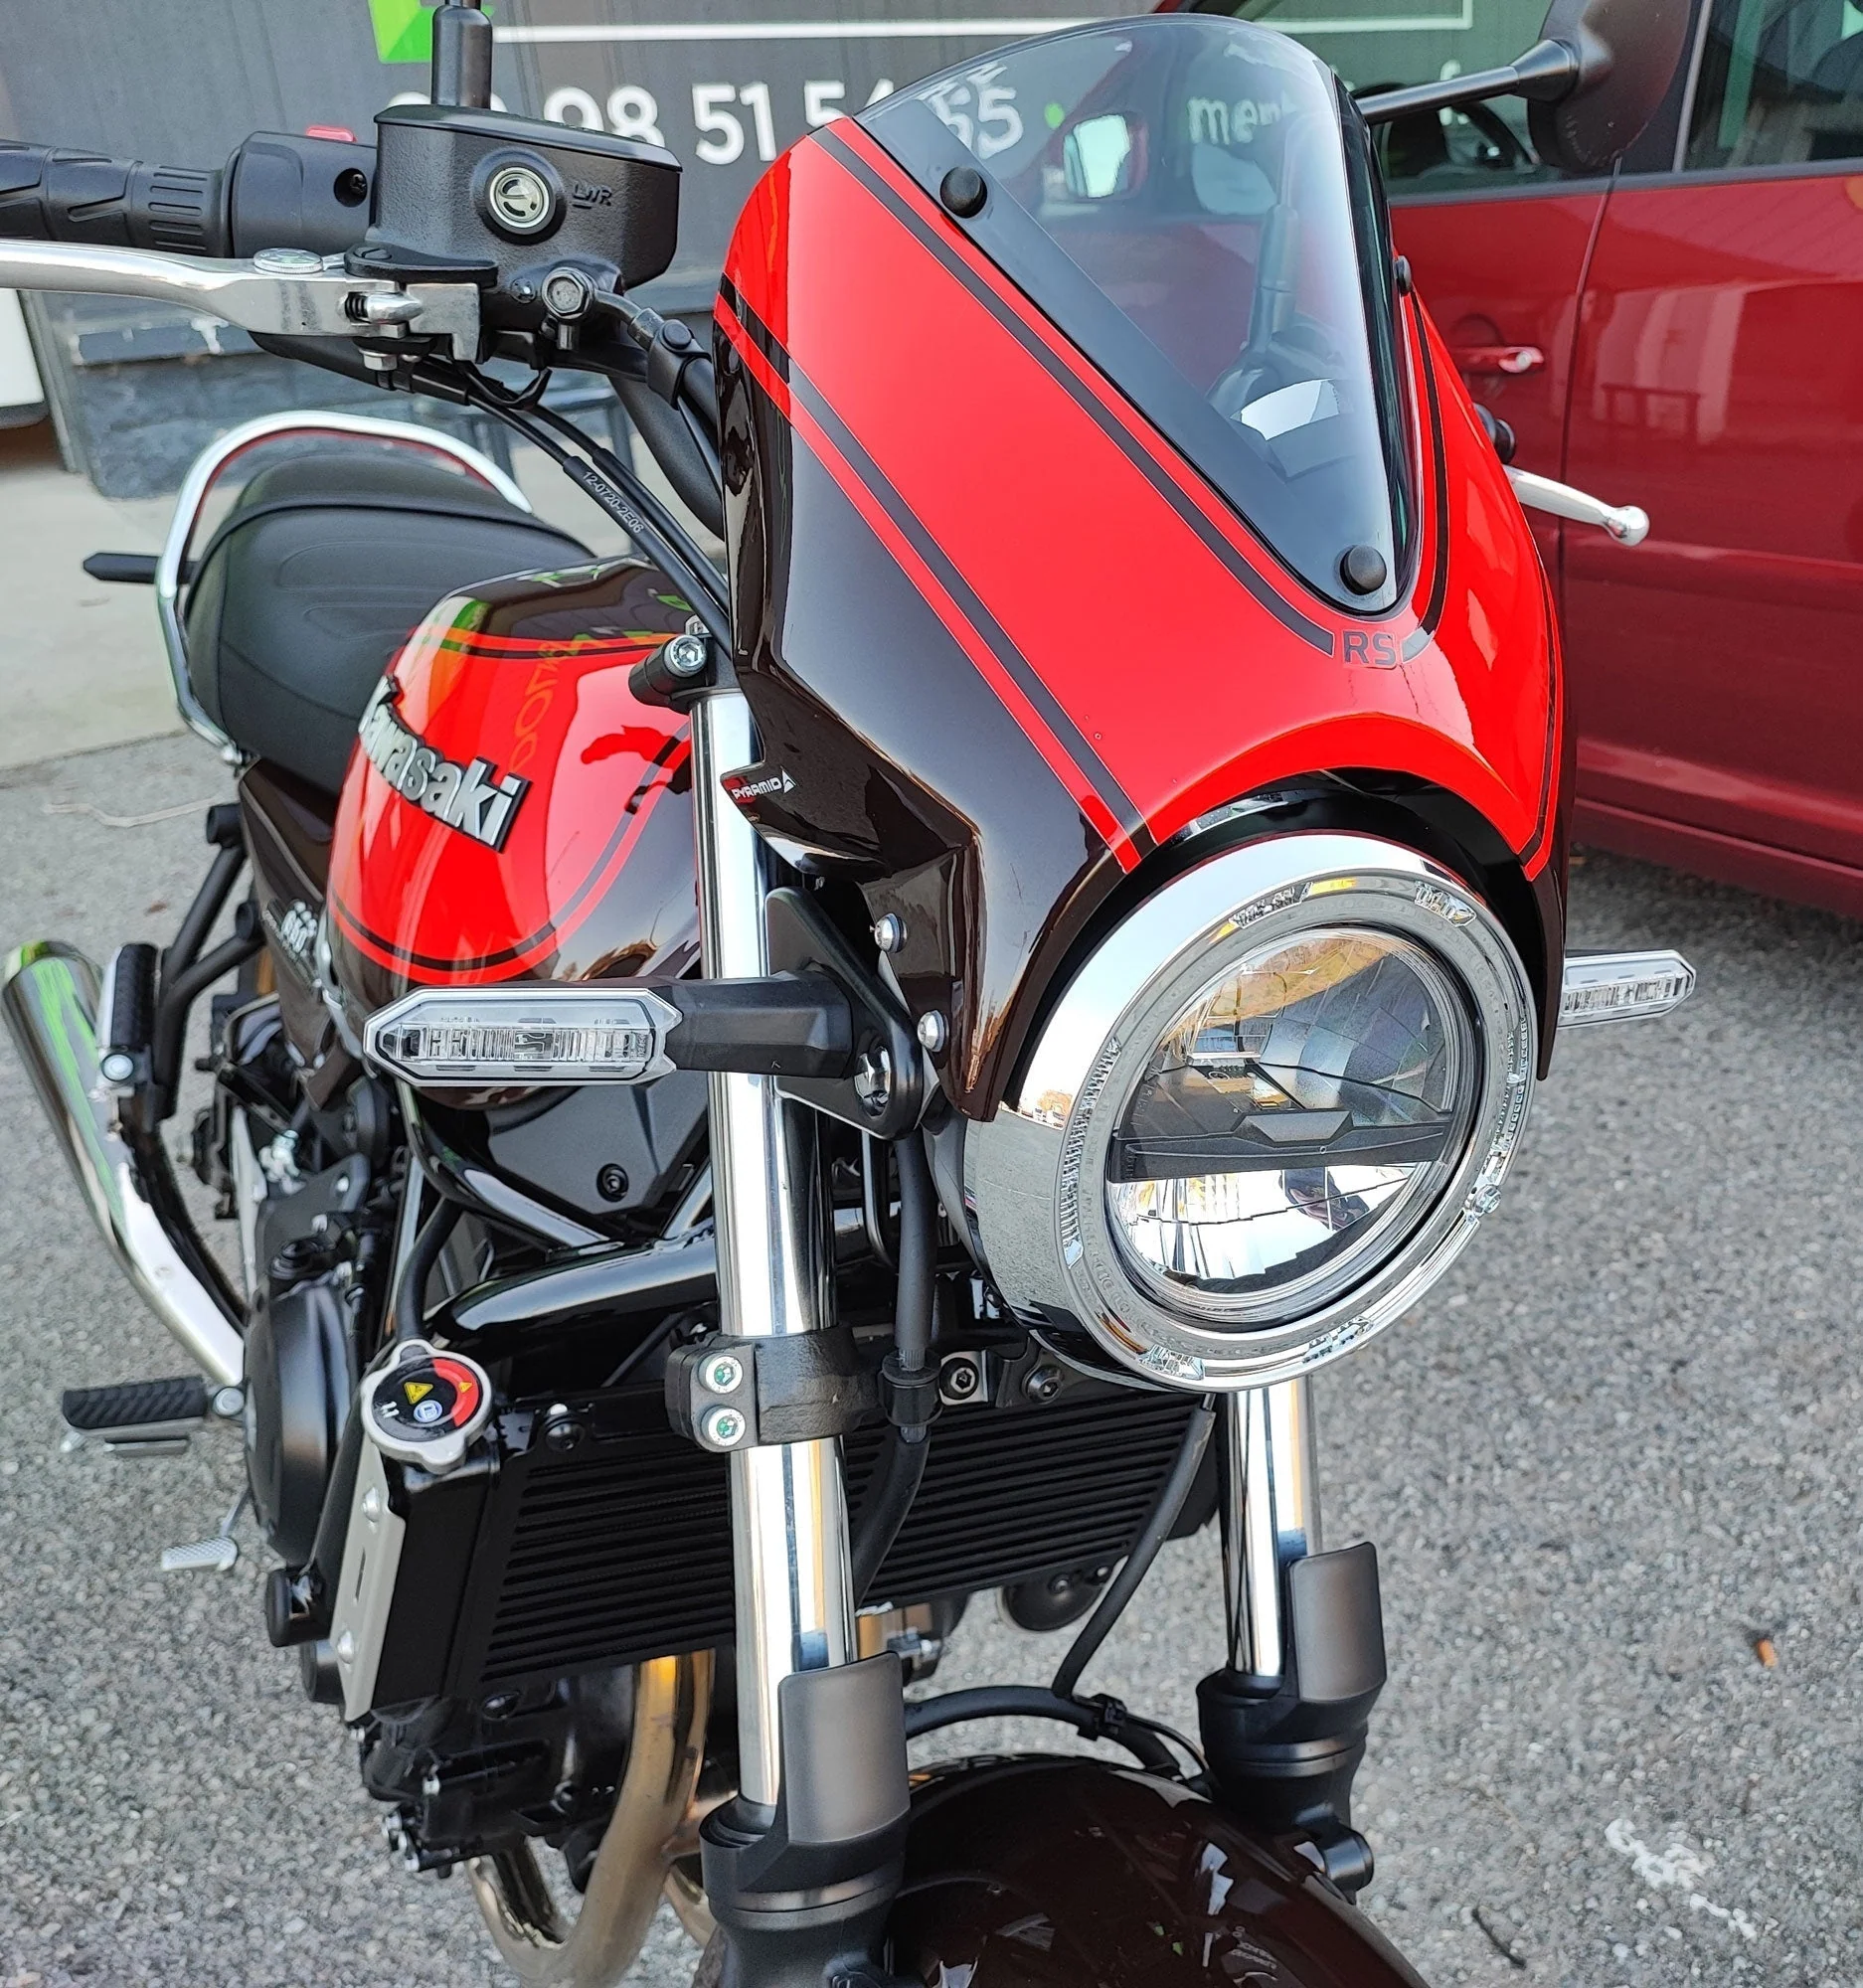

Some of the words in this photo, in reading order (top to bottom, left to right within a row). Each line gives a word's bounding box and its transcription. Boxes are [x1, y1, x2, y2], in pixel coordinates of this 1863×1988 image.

[543, 85, 666, 148] 98
[691, 82, 778, 166] 51
[582, 471, 644, 535] 12-0720-2E06
[1342, 629, 1397, 667] RS
[731, 776, 783, 800] PYRAMID
